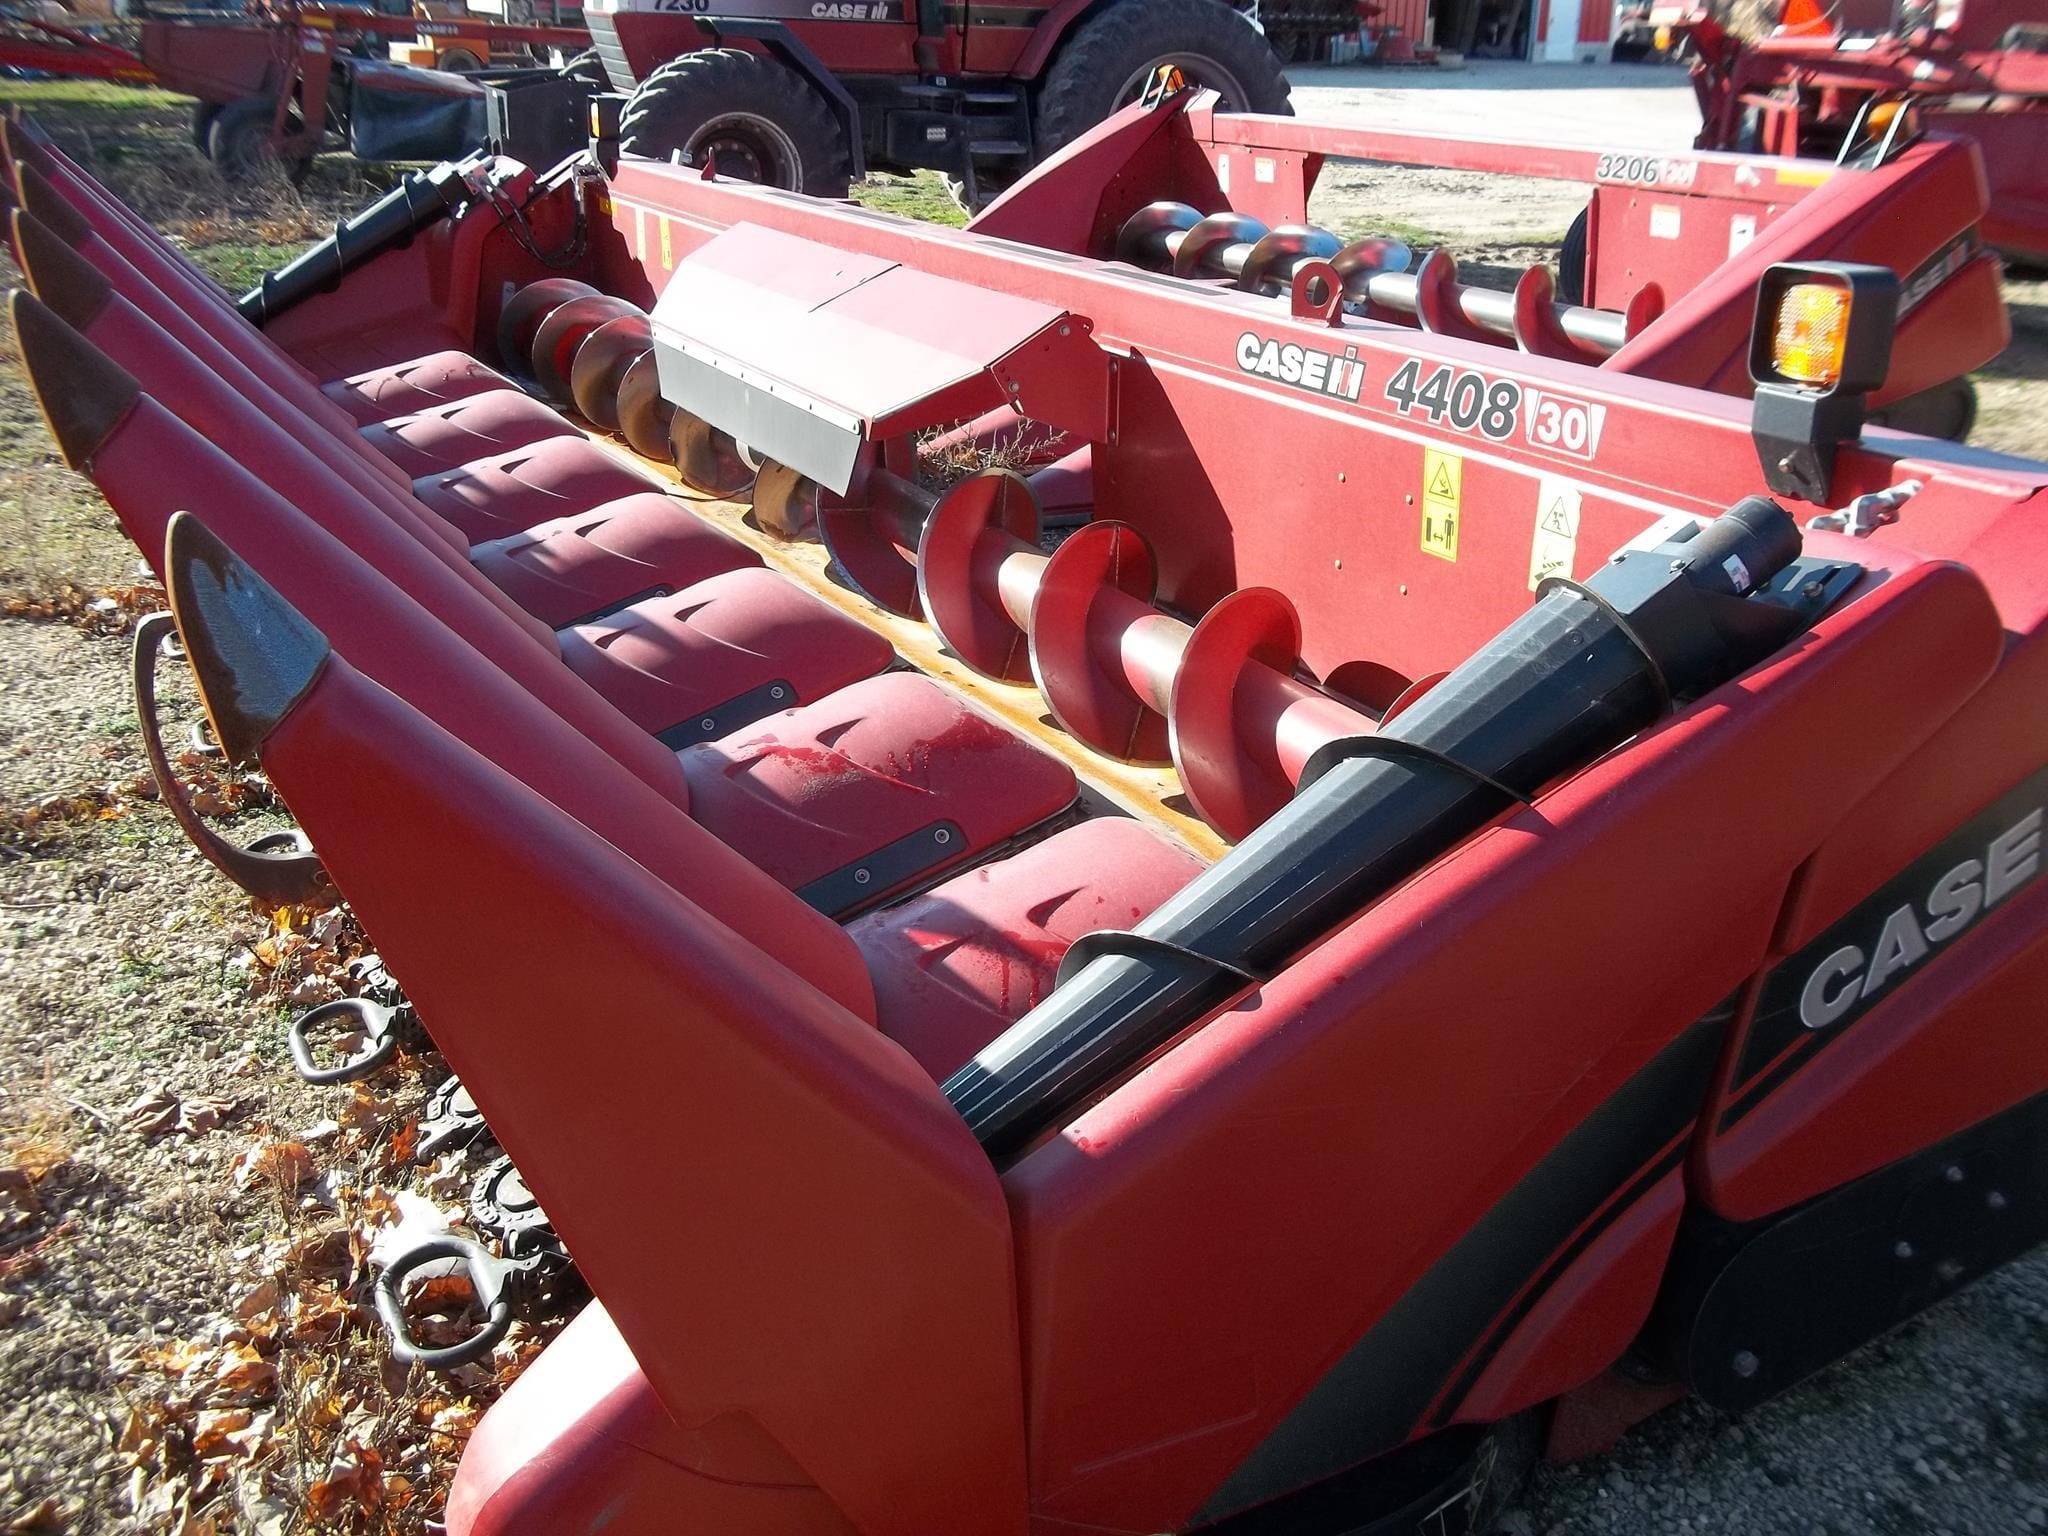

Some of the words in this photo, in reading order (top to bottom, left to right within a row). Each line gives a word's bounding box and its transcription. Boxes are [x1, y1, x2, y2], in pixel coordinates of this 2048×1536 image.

[811, 2, 867, 18] CASE
[1597, 155, 1659, 183] 3206
[1236, 333, 1328, 391] CASE
[1386, 357, 1521, 440] 4408
[1537, 403, 1588, 450] 30
[1800, 807, 2043, 1028] CASE
